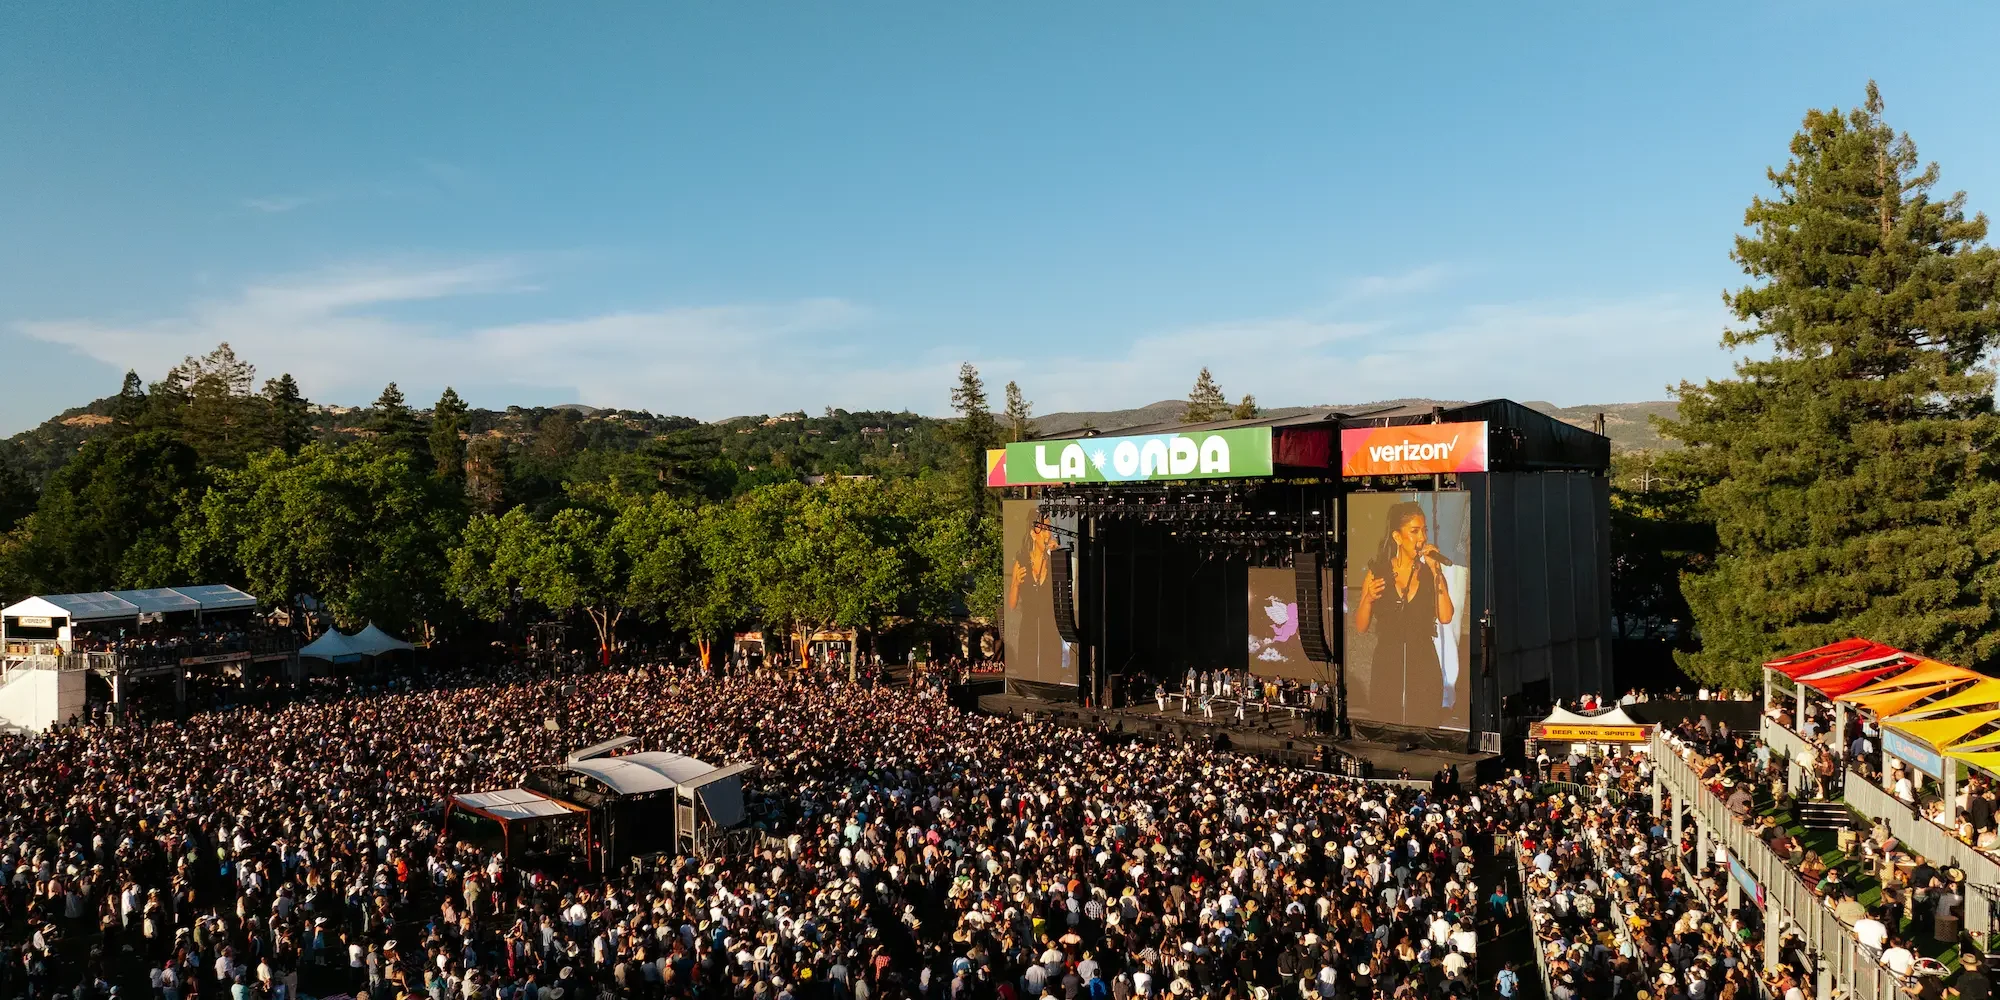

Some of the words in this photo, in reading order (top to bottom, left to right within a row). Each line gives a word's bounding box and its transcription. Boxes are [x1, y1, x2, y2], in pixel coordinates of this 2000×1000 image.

[1035, 444, 1086, 479] LA
[1113, 435, 1230, 477] ONDA
[1369, 439, 1449, 462] verizon
